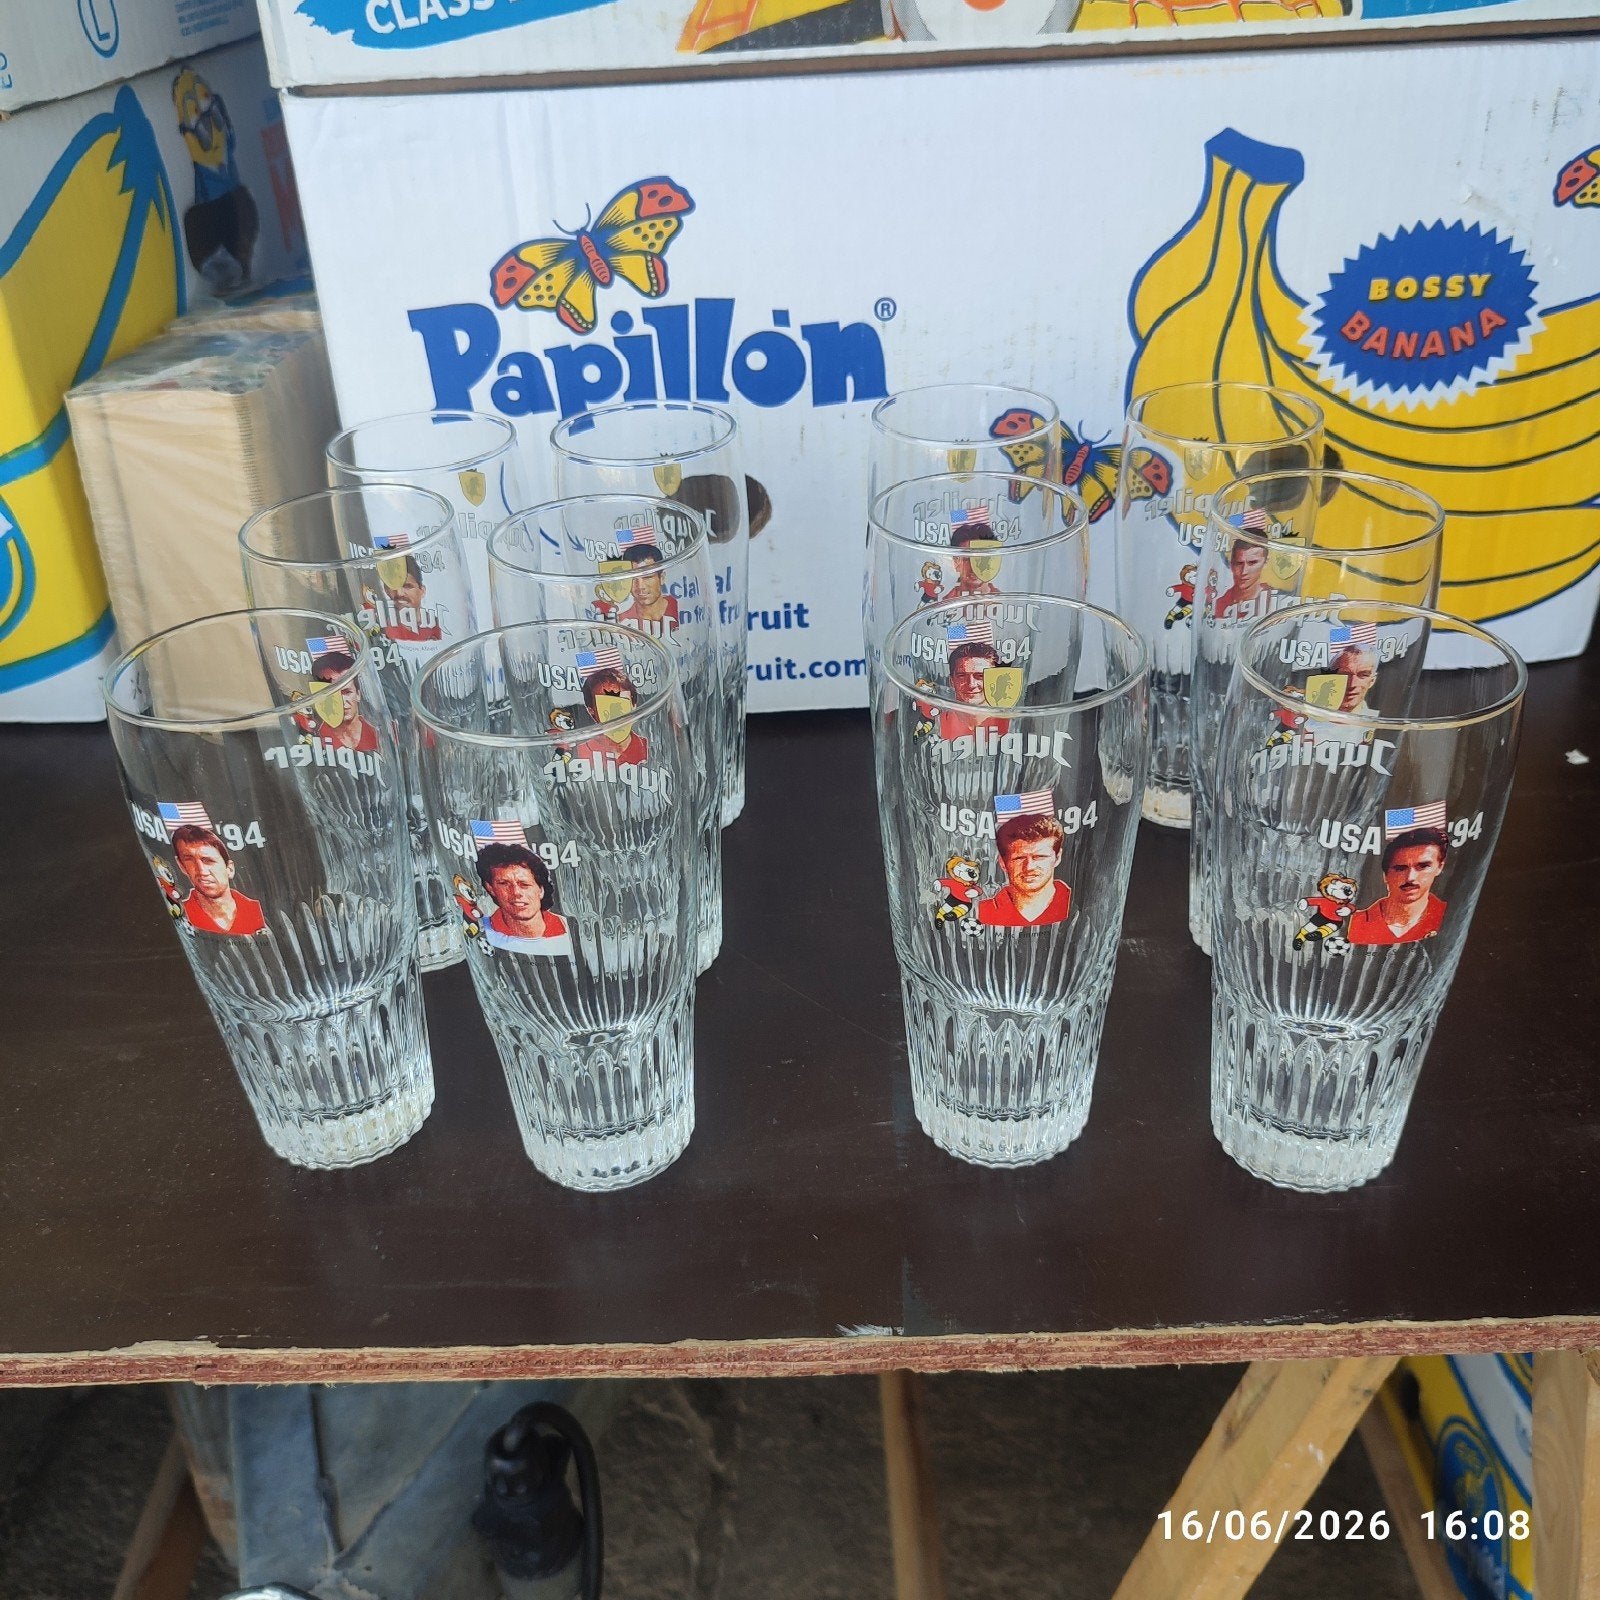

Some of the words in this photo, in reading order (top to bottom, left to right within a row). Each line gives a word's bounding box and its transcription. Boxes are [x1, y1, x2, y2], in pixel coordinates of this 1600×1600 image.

[1368, 272, 1492, 301] BOSSY
[1339, 306, 1508, 360] BANANA
[913, 519, 951, 546] USA
[991, 517, 1022, 543] '94
[415, 550, 446, 574] '94
[583, 537, 620, 563] USA
[274, 645, 313, 675] USA
[911, 632, 949, 664] USA
[996, 636, 1032, 664] '94
[1278, 638, 1329, 668] USA
[1377, 633, 1410, 663] '94
[537, 661, 583, 692] USA
[625, 659, 658, 689] '94
[130, 802, 171, 846] USA
[215, 820, 267, 852] '94
[938, 802, 997, 841] USA
[1057, 799, 1099, 836] '94
[1318, 818, 1382, 856] USA
[1447, 811, 1485, 849] '94
[436, 818, 479, 864] USA
[531, 839, 582, 871] '94
